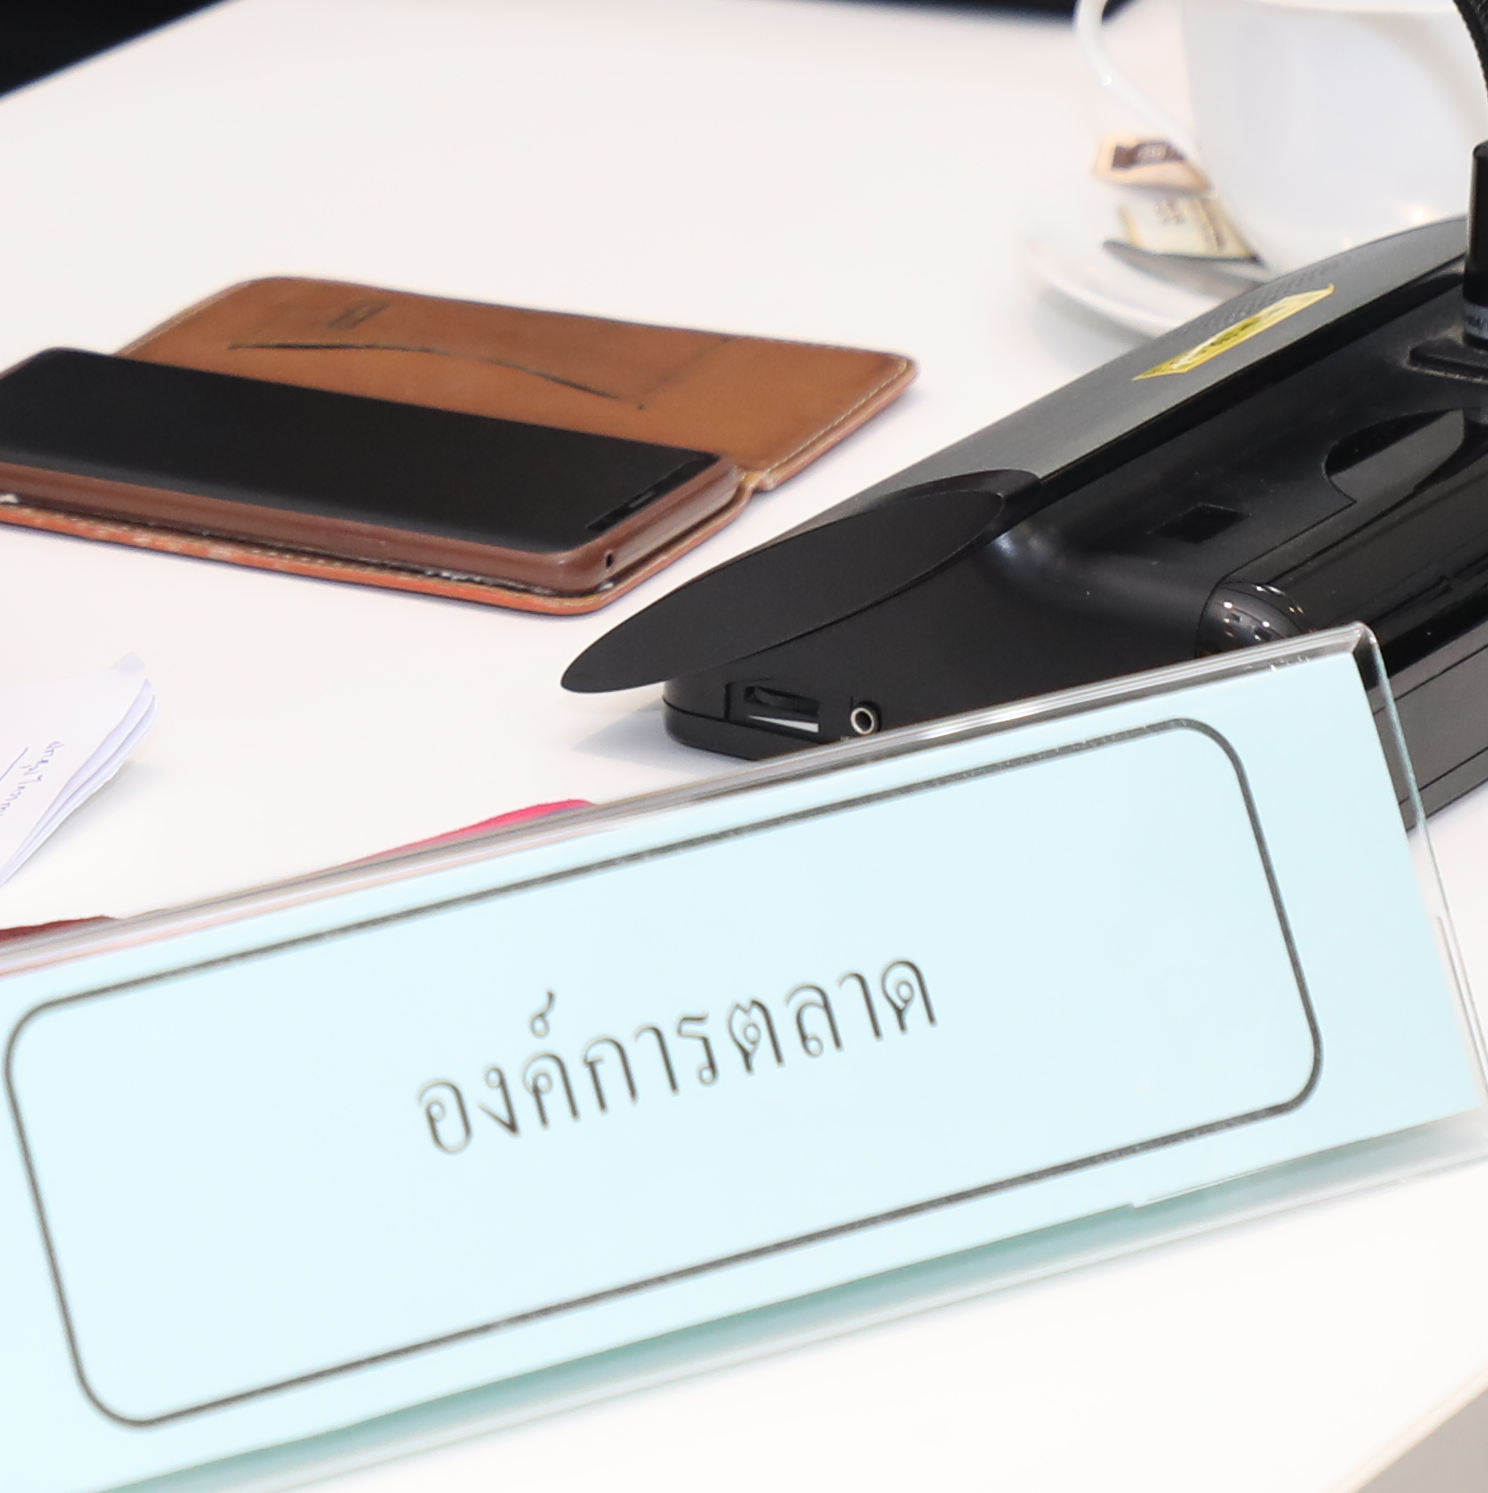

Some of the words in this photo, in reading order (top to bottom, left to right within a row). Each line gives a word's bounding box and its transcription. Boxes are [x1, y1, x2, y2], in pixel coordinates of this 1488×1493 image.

[417, 958, 937, 1155] องค์การตลาด
